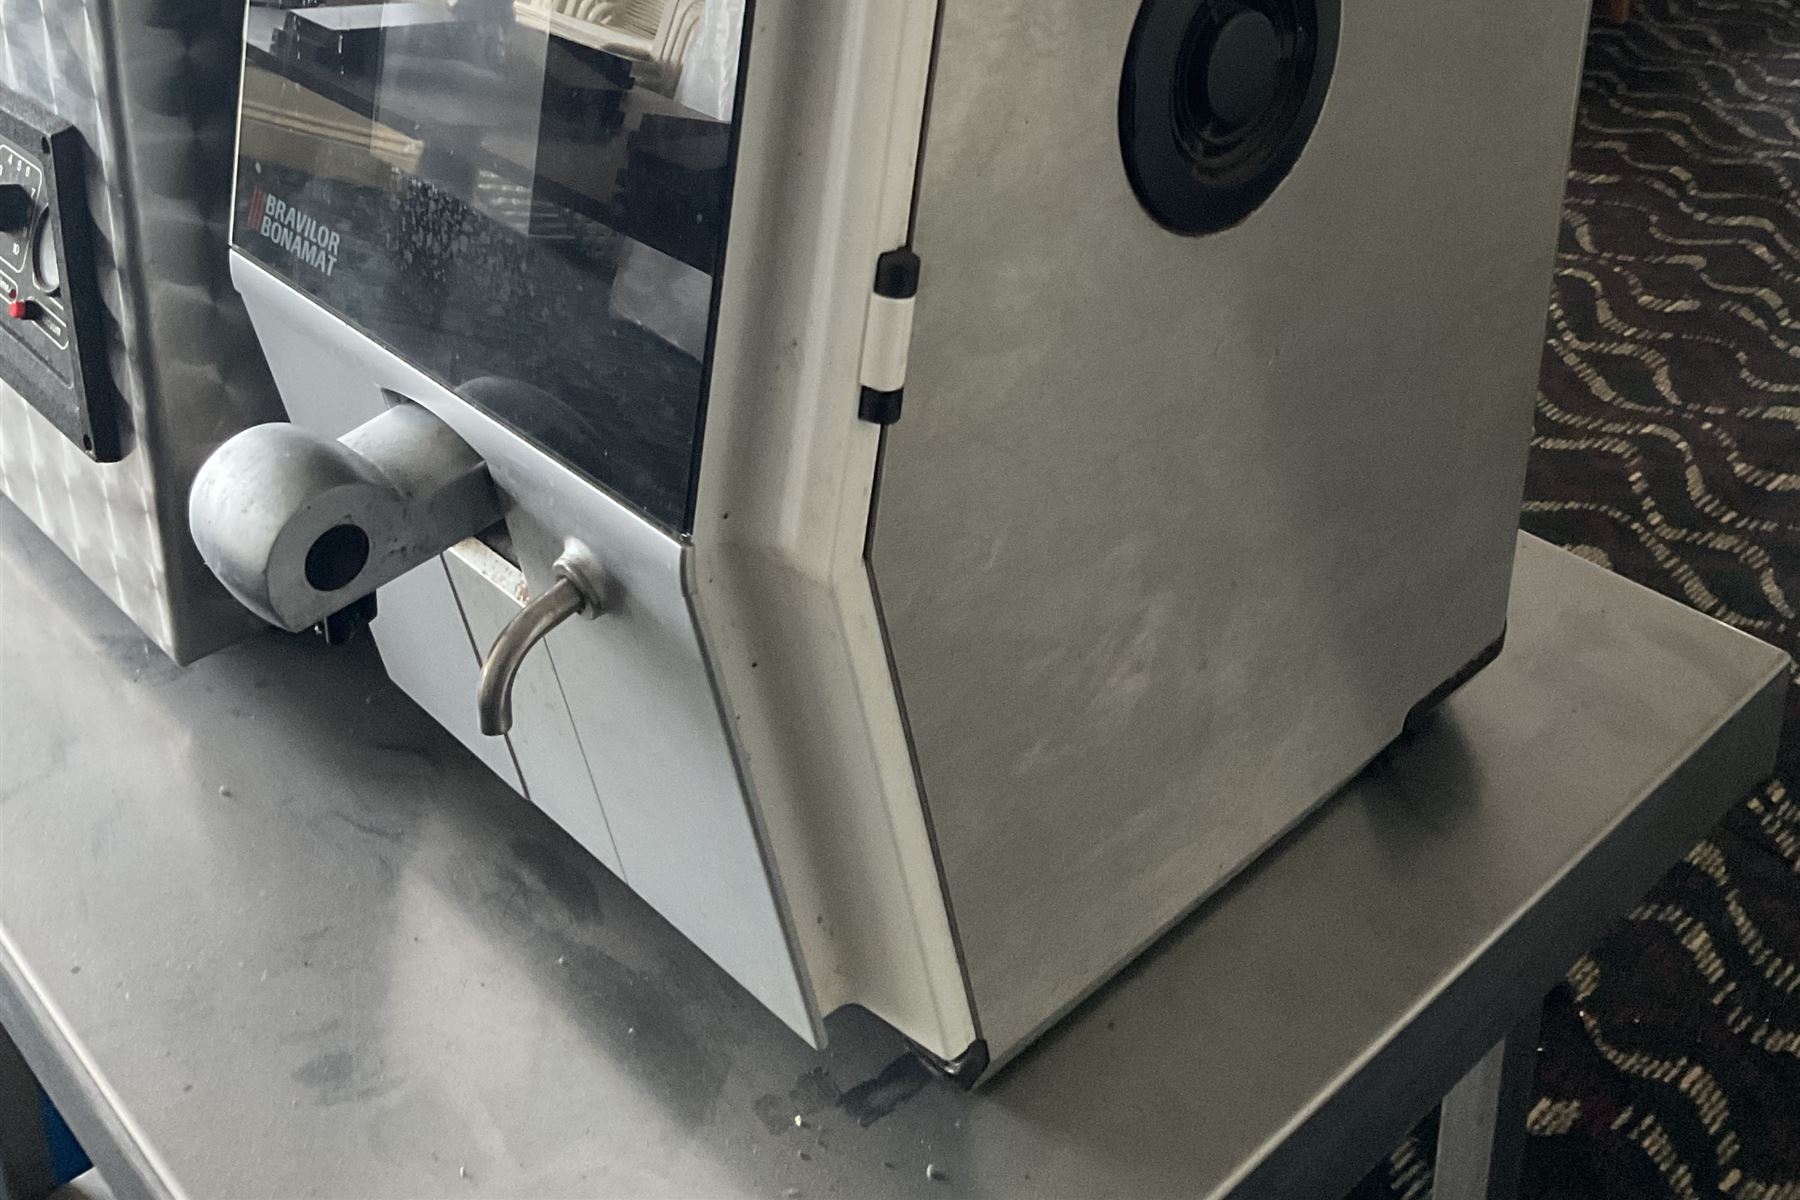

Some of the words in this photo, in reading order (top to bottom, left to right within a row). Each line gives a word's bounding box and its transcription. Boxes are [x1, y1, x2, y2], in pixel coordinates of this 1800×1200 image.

[31, 187, 36, 199] 7
[265, 193, 340, 255] BRAVILOR
[13, 243, 20, 255] 10
[260, 215, 337, 276] BONAMAT
